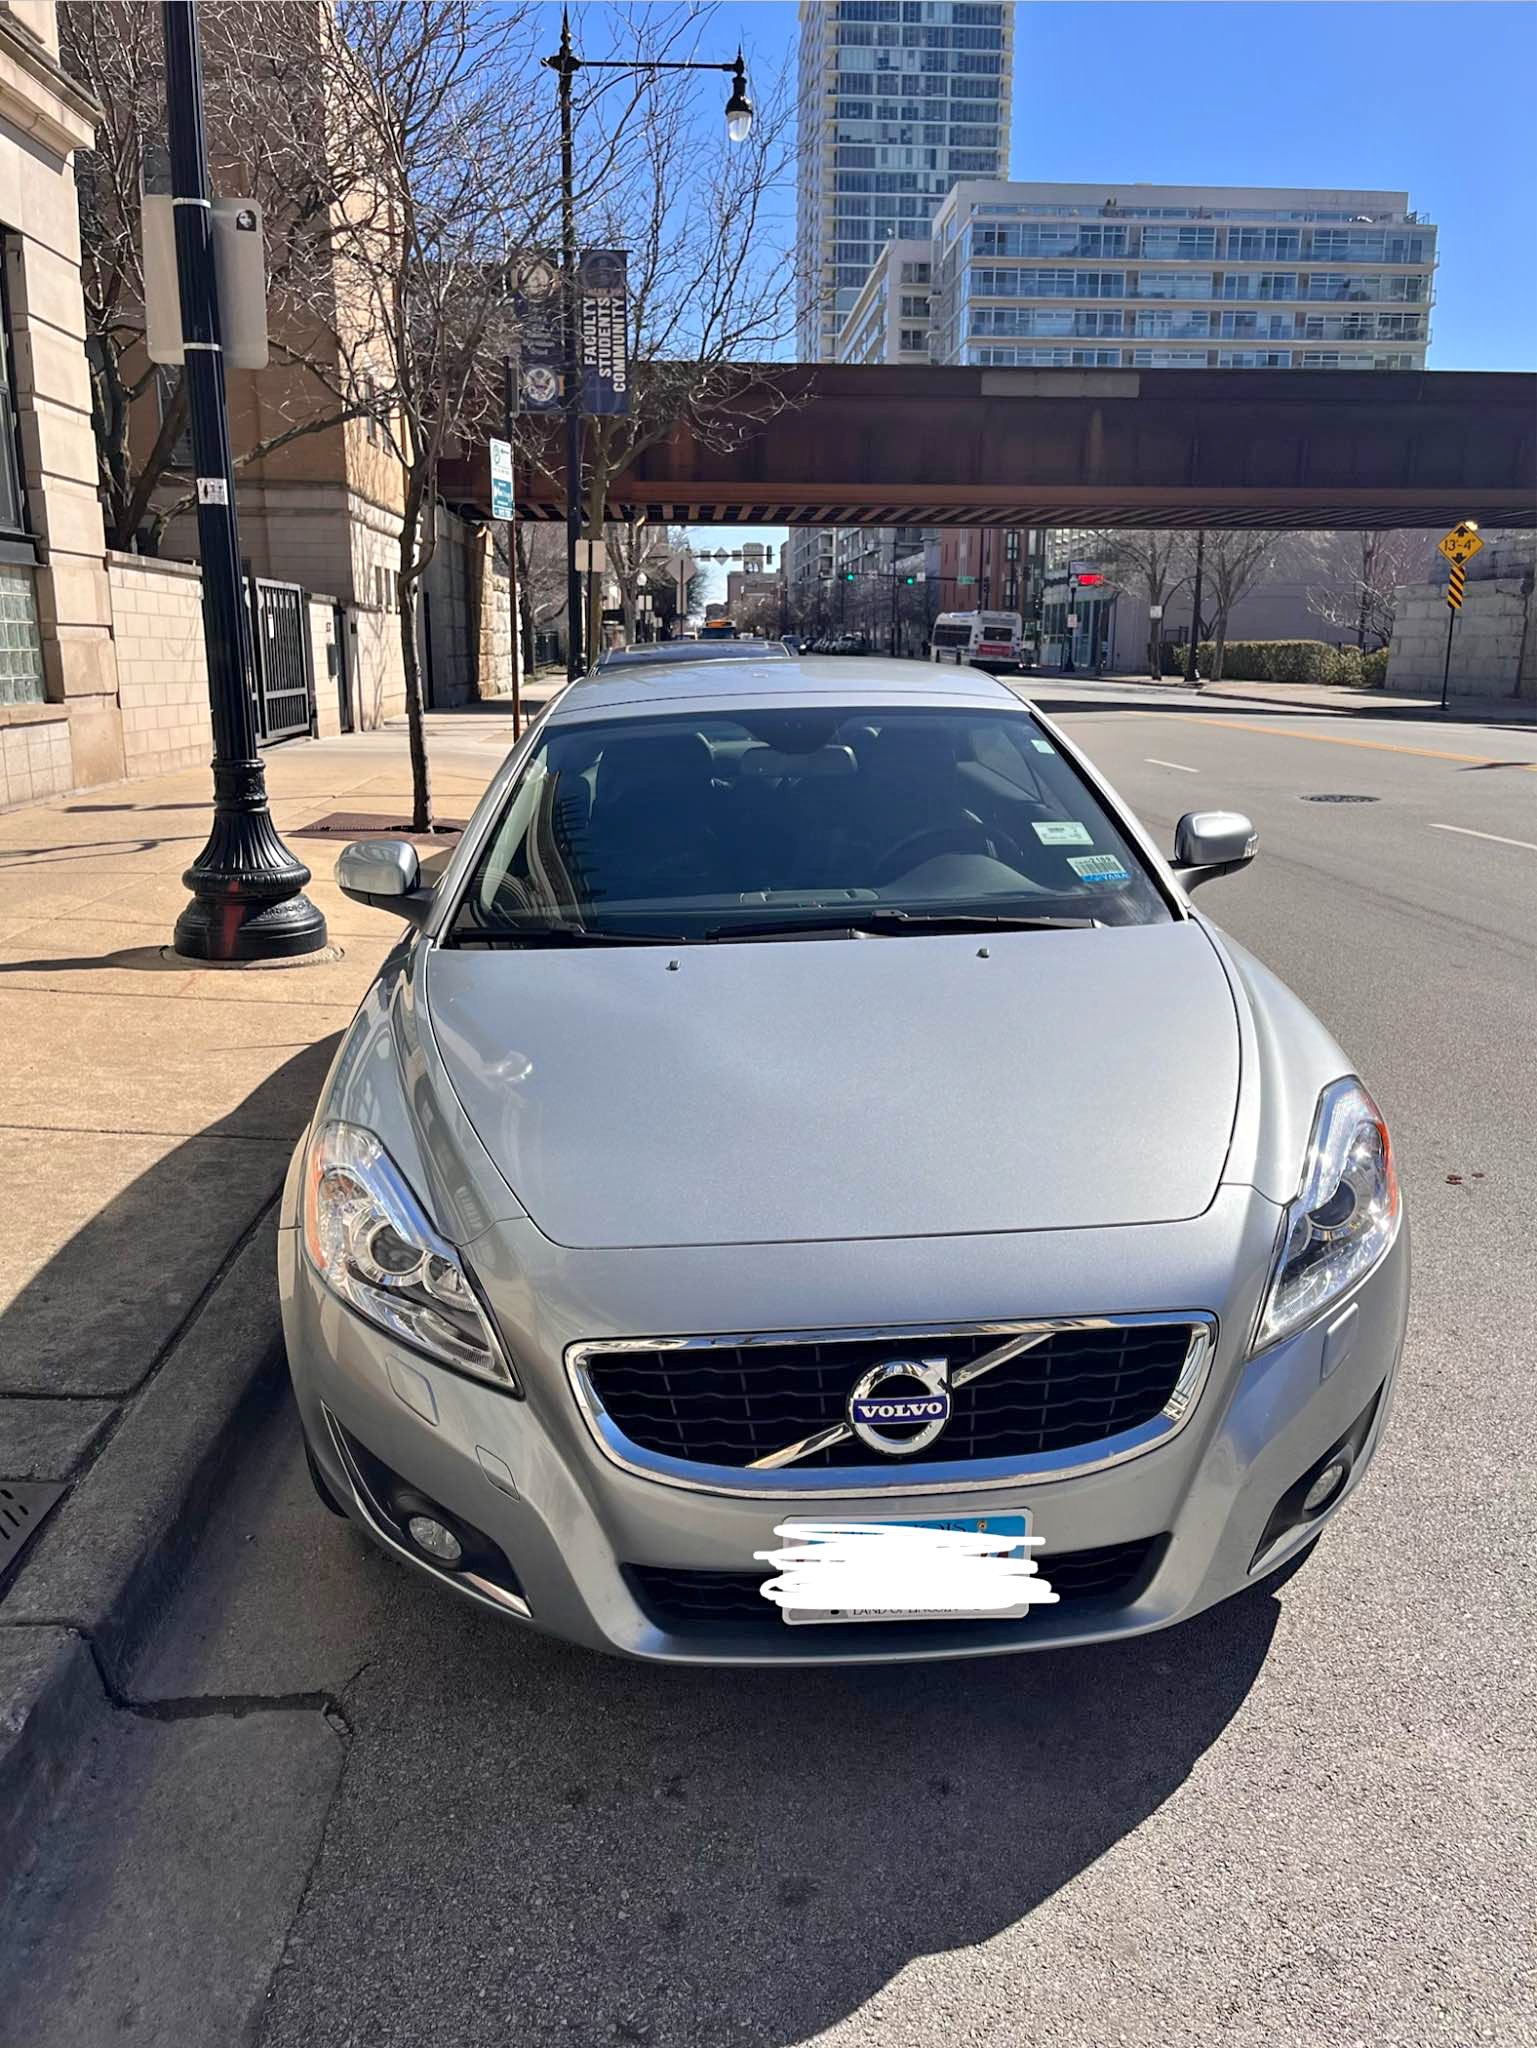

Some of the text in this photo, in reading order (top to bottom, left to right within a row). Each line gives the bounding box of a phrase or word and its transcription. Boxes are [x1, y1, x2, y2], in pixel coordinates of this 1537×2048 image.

[583, 297, 598, 366] FACULTY
[598, 296, 612, 378] STUDENTS
[612, 297, 627, 393] COMMUNITY
[858, 1402, 943, 1418] VOLVO
